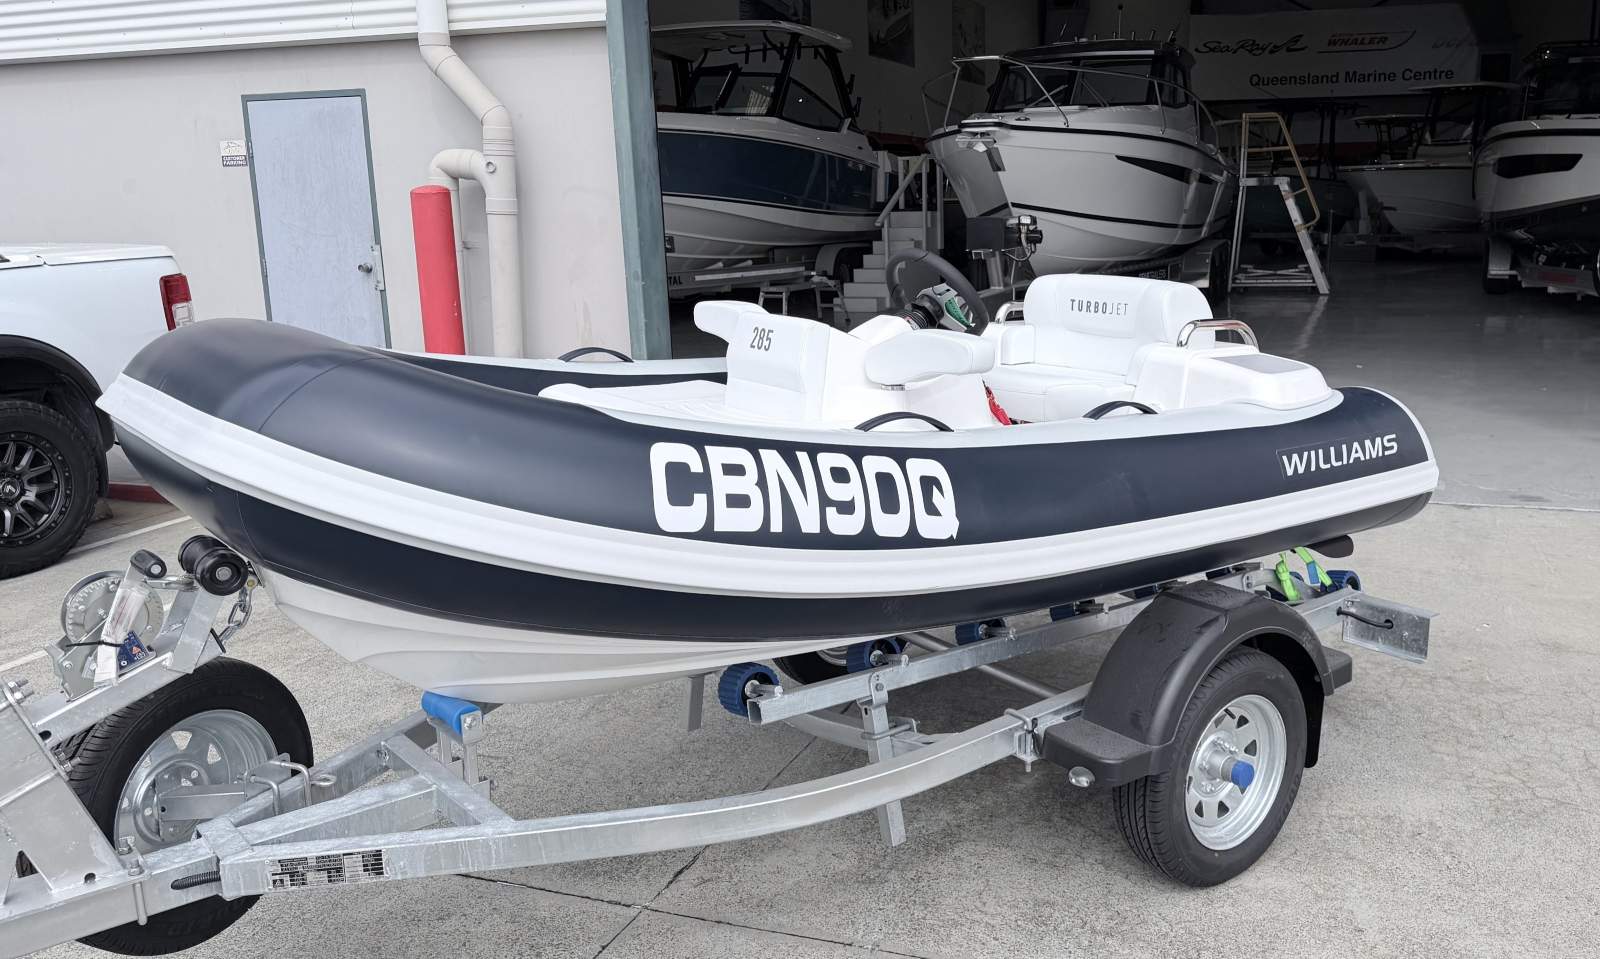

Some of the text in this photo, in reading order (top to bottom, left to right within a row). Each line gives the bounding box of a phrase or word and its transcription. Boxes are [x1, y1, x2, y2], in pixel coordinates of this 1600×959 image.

[1327, 36, 1389, 47] WHALER
[1249, 68, 1454, 87] Queensland Marine Centre
[1070, 298, 1129, 316] TURBOJET
[750, 326, 774, 352] 285
[1281, 433, 1398, 477] WILLIAMS
[649, 441, 960, 540] CBN90Q
